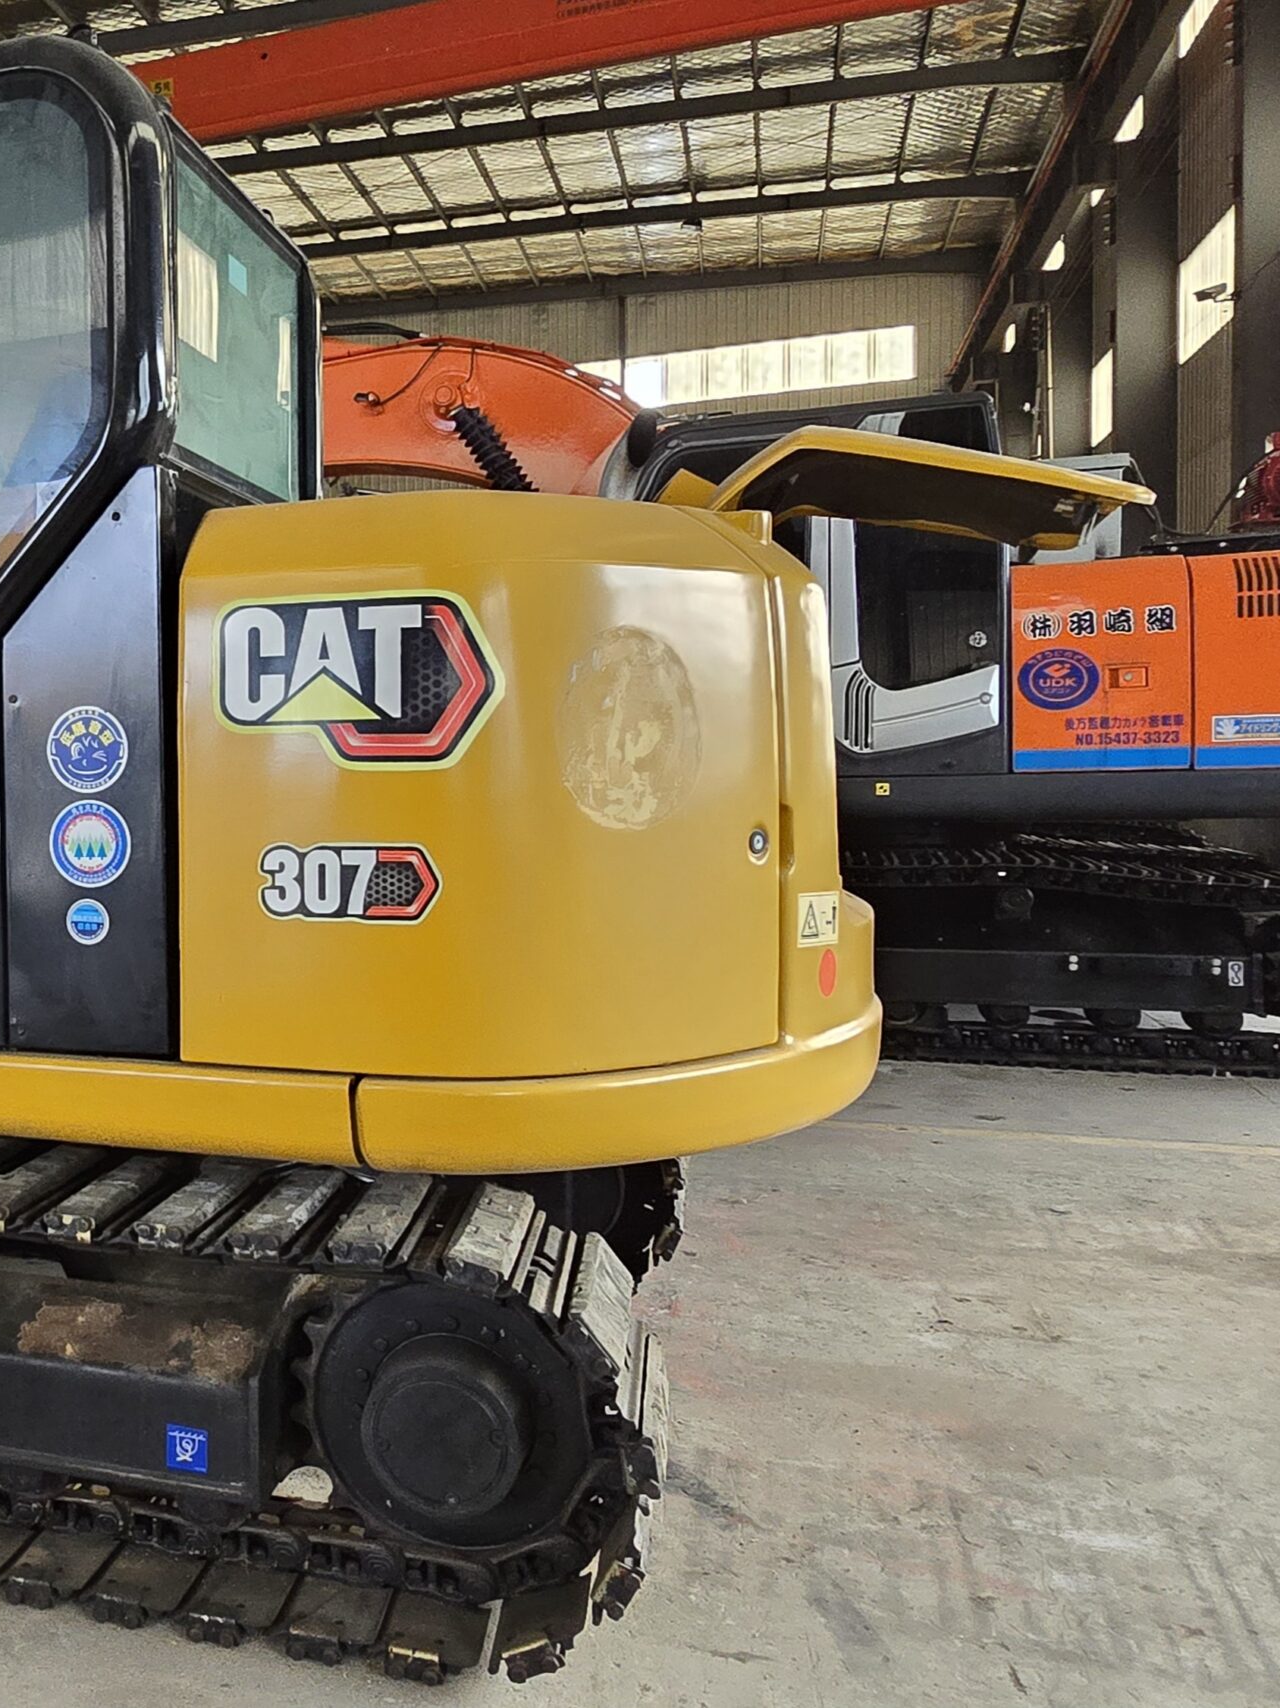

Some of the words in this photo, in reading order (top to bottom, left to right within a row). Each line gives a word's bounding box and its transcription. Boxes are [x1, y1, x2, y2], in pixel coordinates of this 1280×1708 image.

[223, 603, 423, 722] CAT
[1038, 677, 1078, 688] UDK
[262, 848, 378, 916] 307
